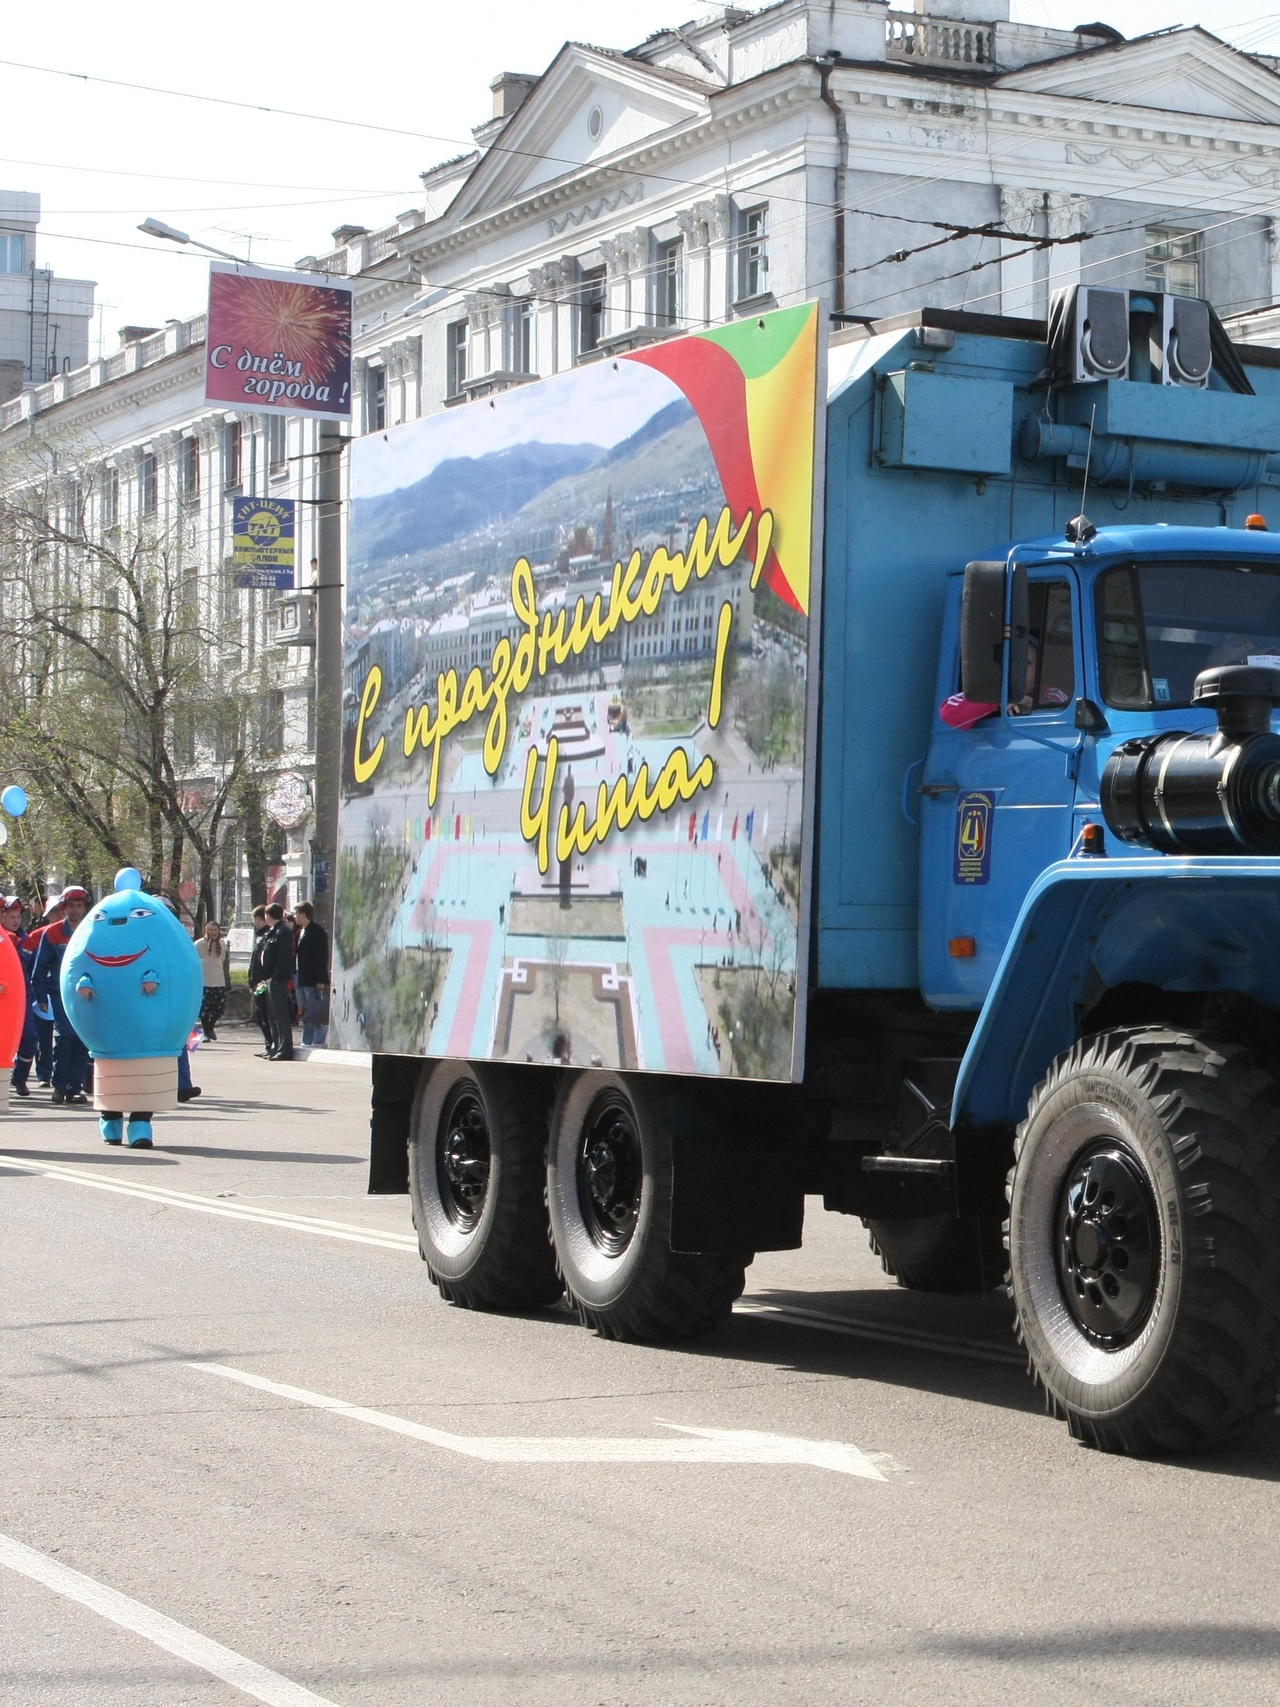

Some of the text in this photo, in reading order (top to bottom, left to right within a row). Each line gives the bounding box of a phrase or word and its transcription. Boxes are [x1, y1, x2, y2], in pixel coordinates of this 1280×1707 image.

[210, 345, 302, 377] С днём
[243, 377, 330, 402] города
[354, 505, 775, 808] С праздником,
